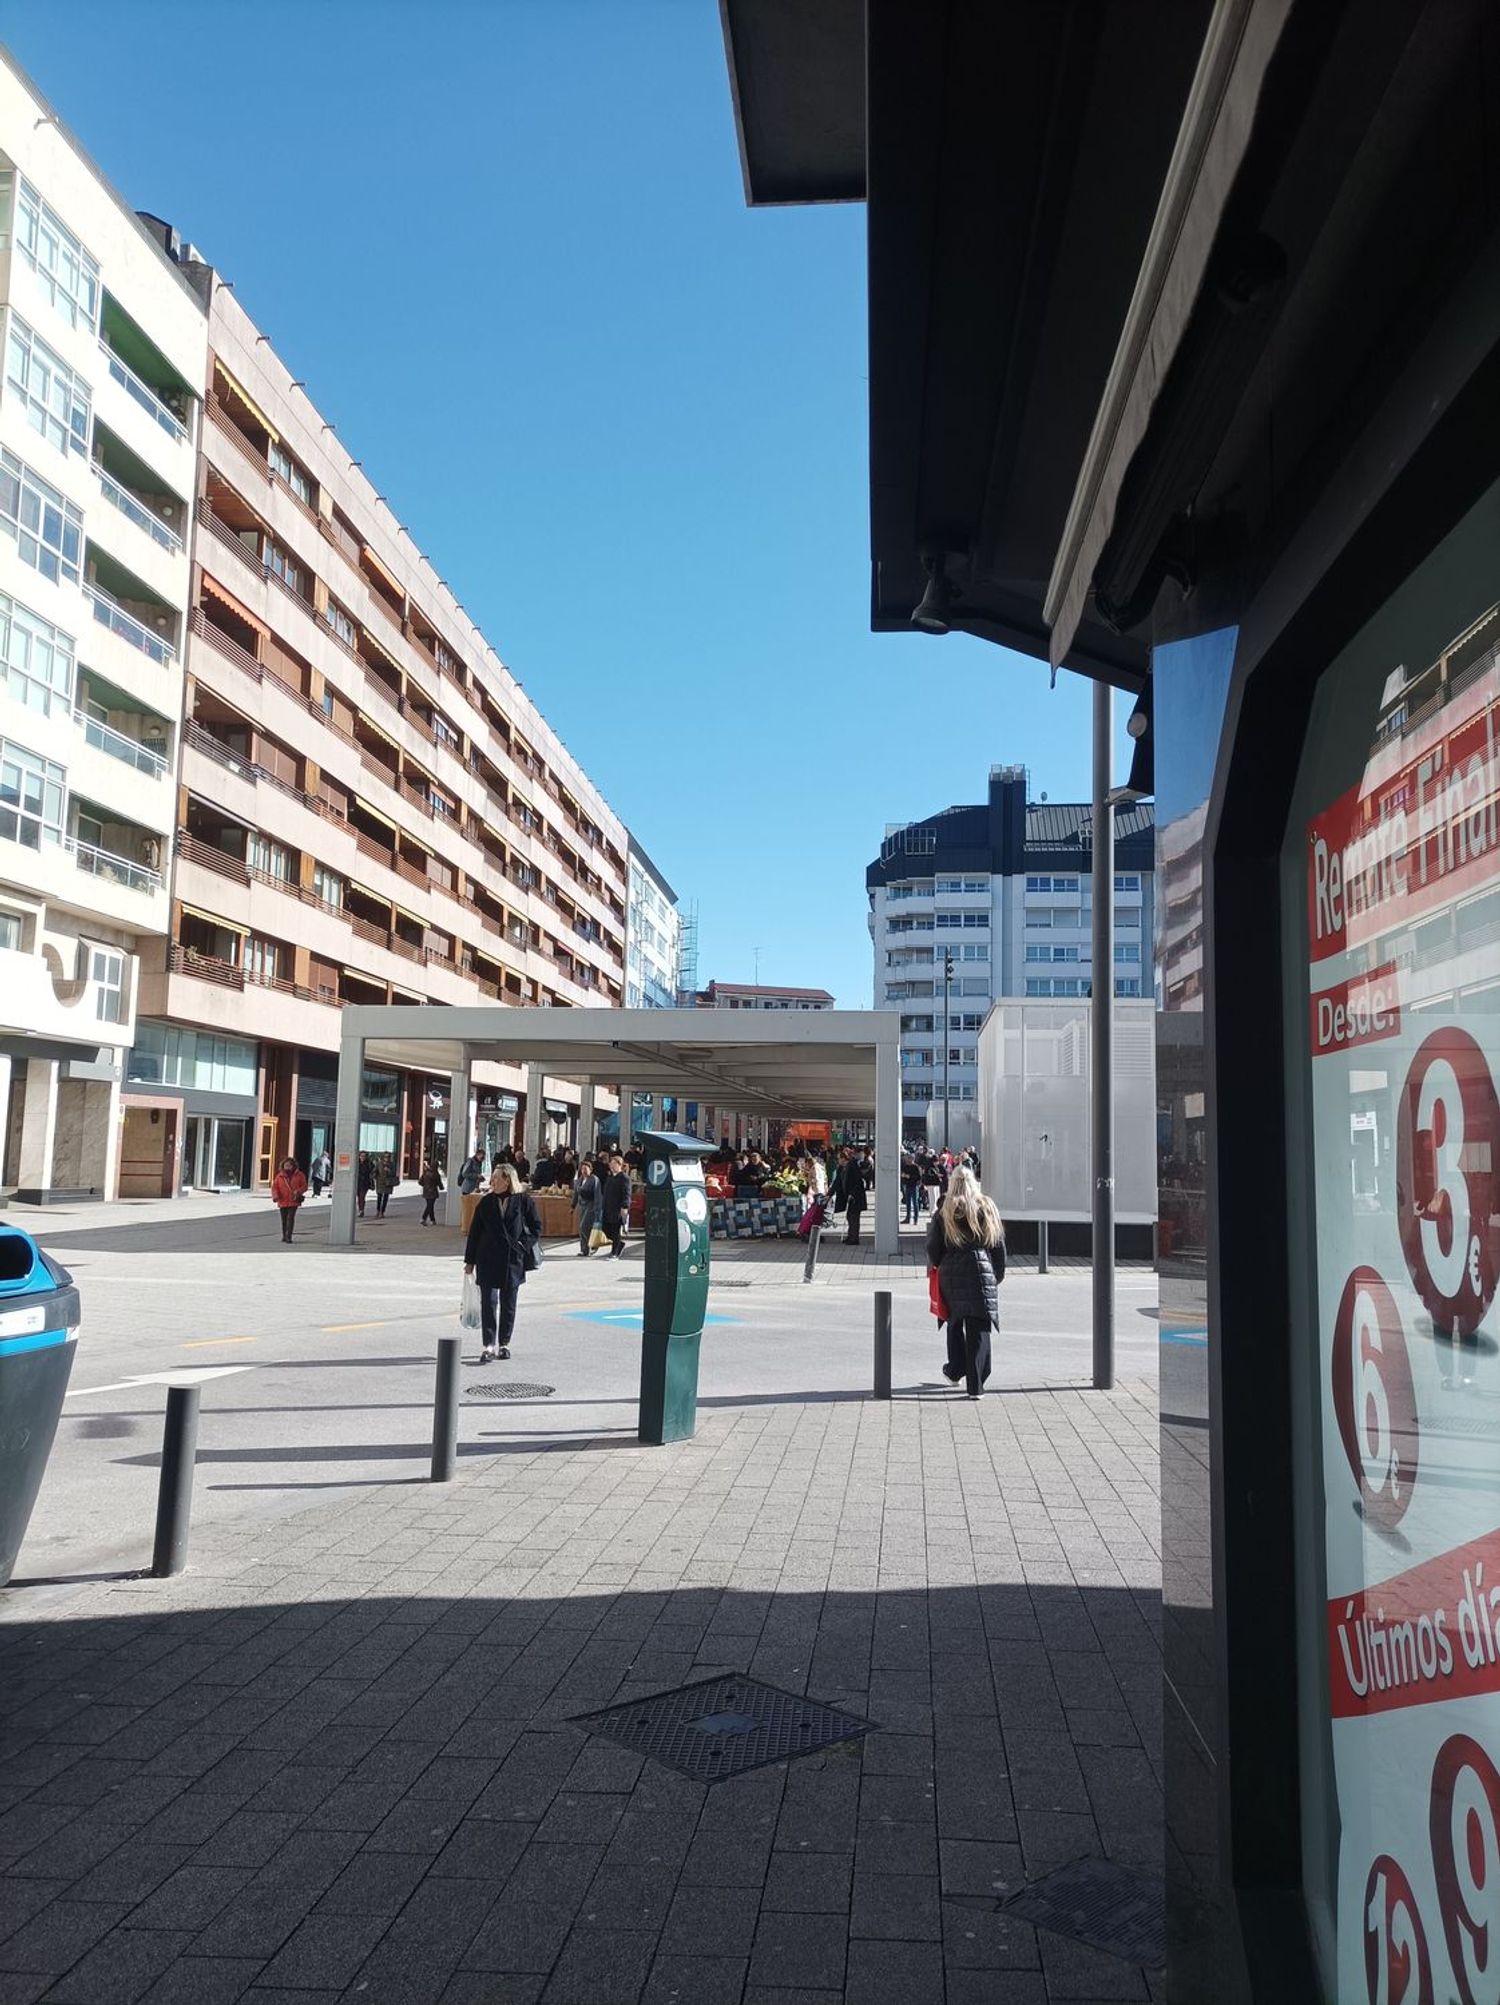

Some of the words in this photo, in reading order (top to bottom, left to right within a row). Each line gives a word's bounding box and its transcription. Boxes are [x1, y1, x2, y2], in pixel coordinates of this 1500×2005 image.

[1314, 801, 1409, 940] Remate
[1318, 978, 1395, 1046] Desde:
[653, 1160, 666, 1186] P
[1337, 1600, 1453, 1696] Últimos
